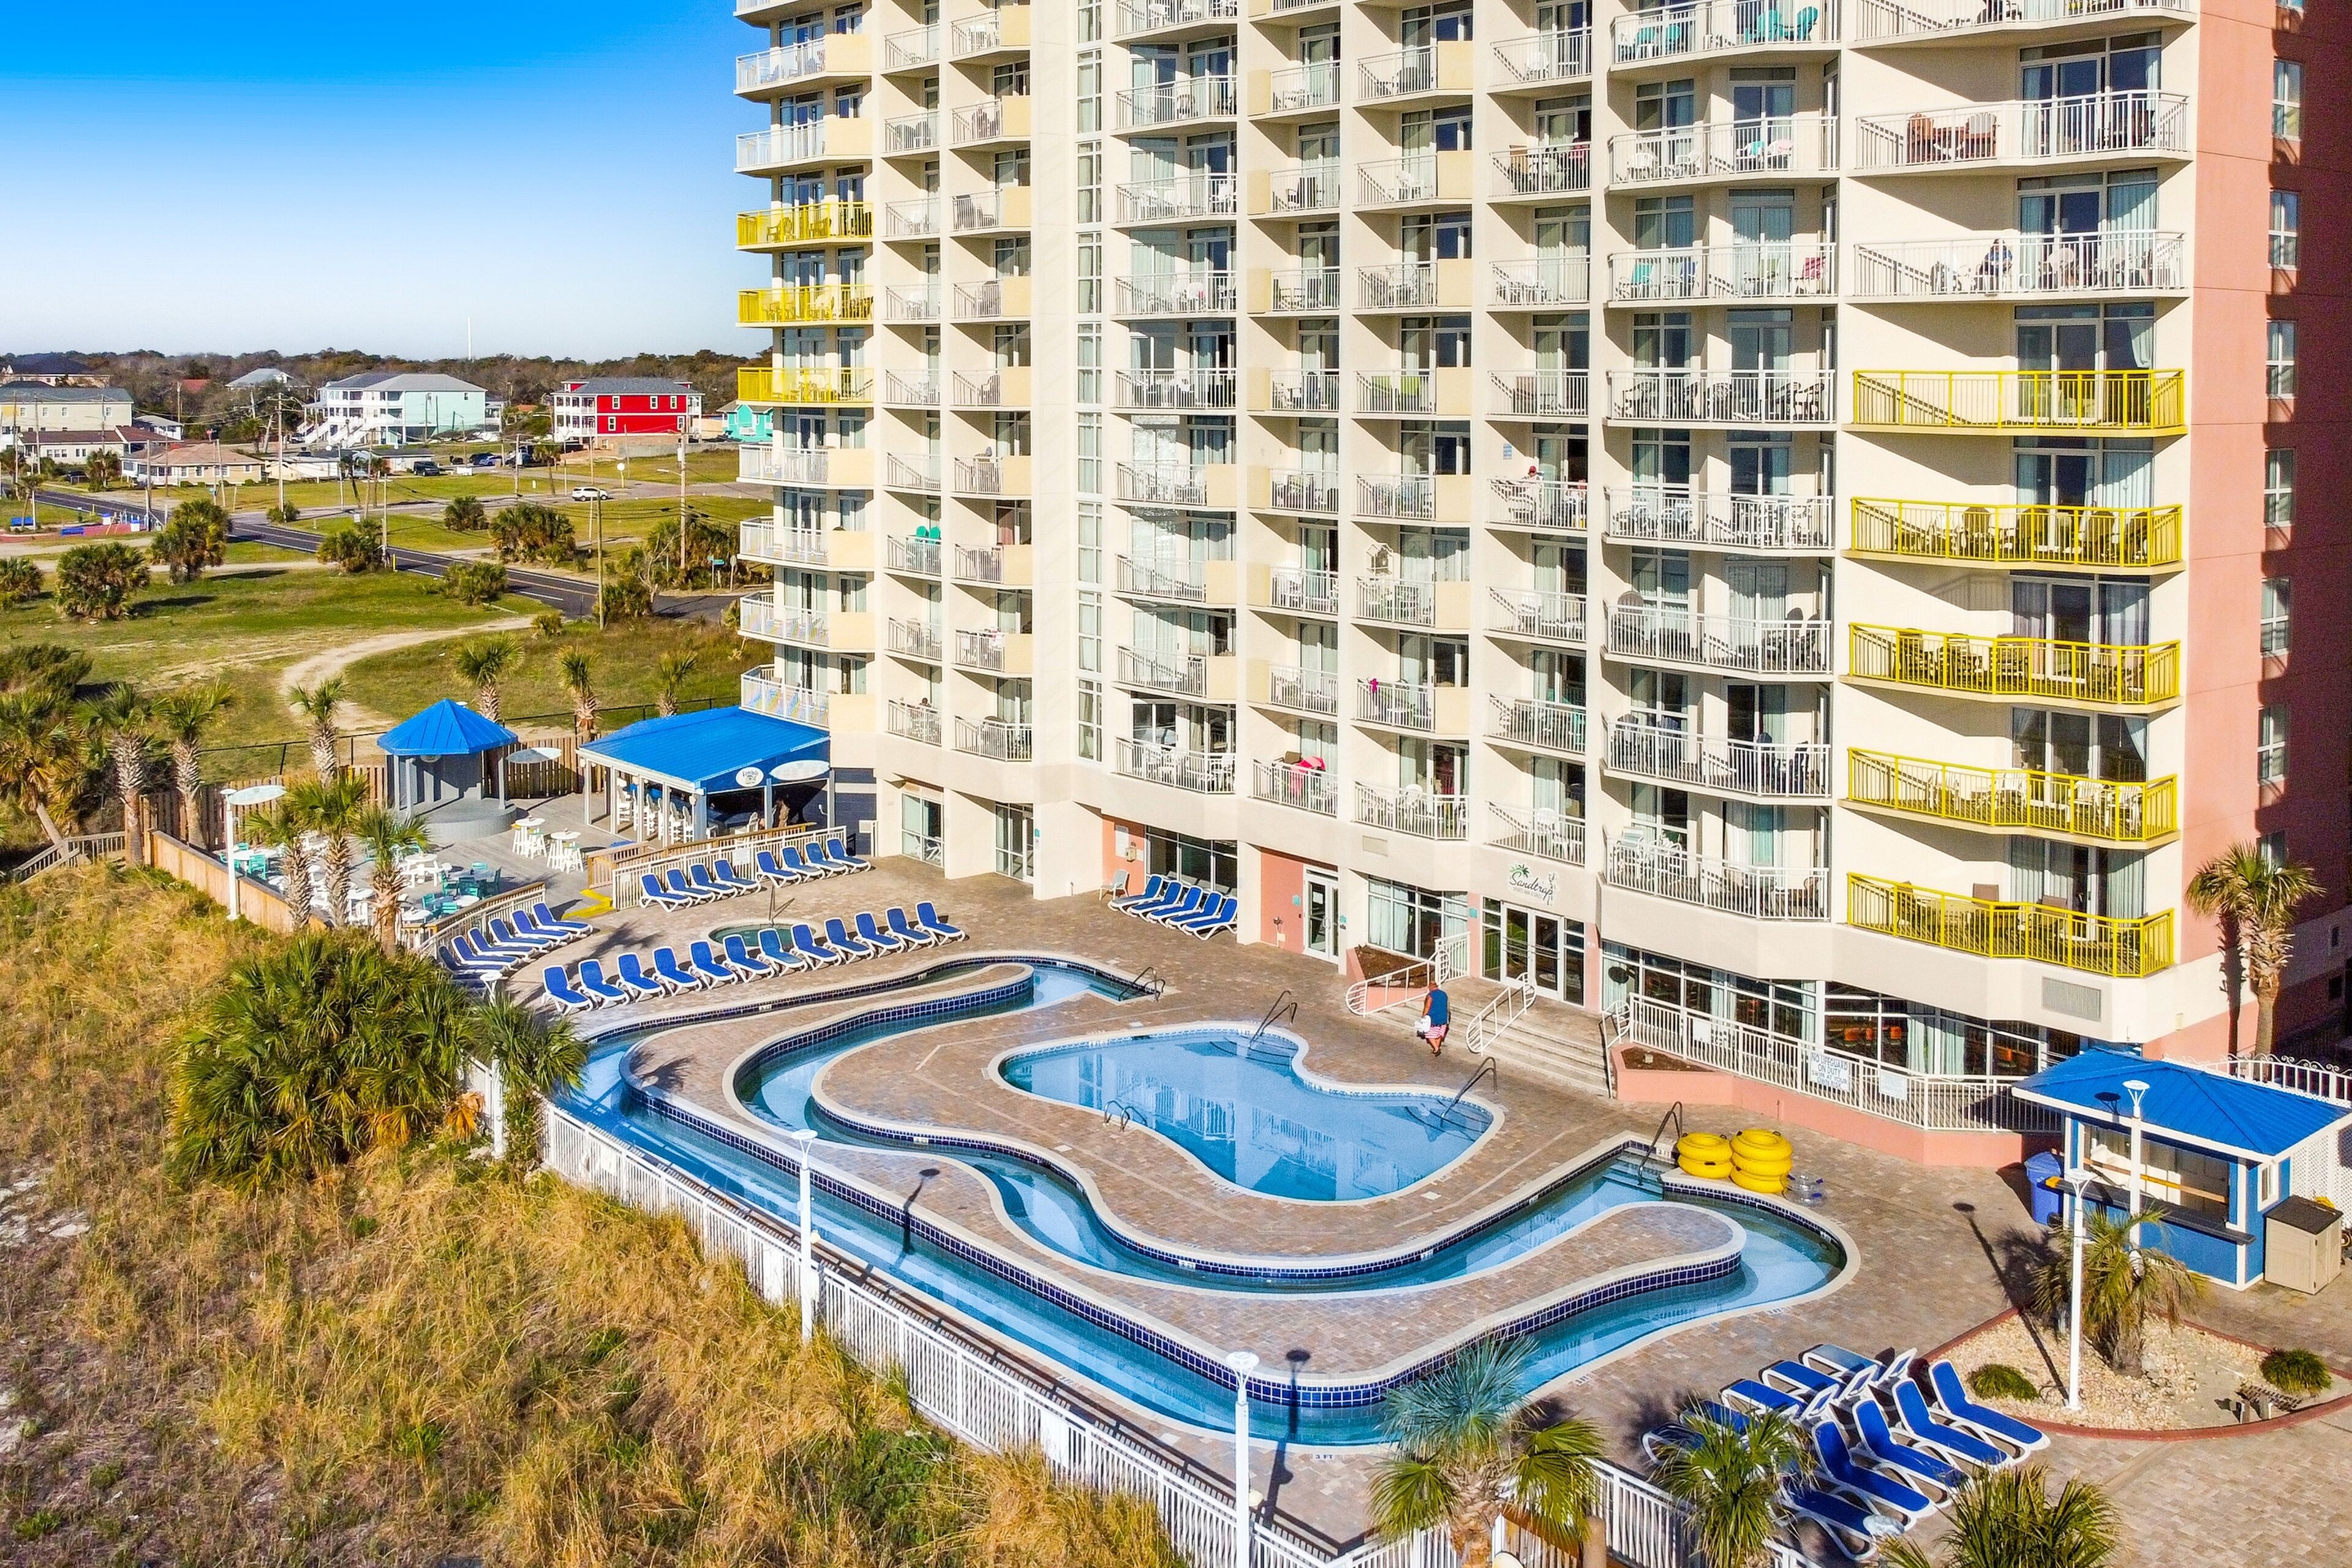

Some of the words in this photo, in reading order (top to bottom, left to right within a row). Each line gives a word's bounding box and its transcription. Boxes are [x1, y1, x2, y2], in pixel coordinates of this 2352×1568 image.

[1509, 871, 1553, 900] Sandtrap
[1811, 1053, 1819, 1062] NO
[1821, 1055, 1848, 1071] LIFEGUARD
[1818, 1063, 1826, 1072] ON
[1827, 1066, 1841, 1077] DUTY
